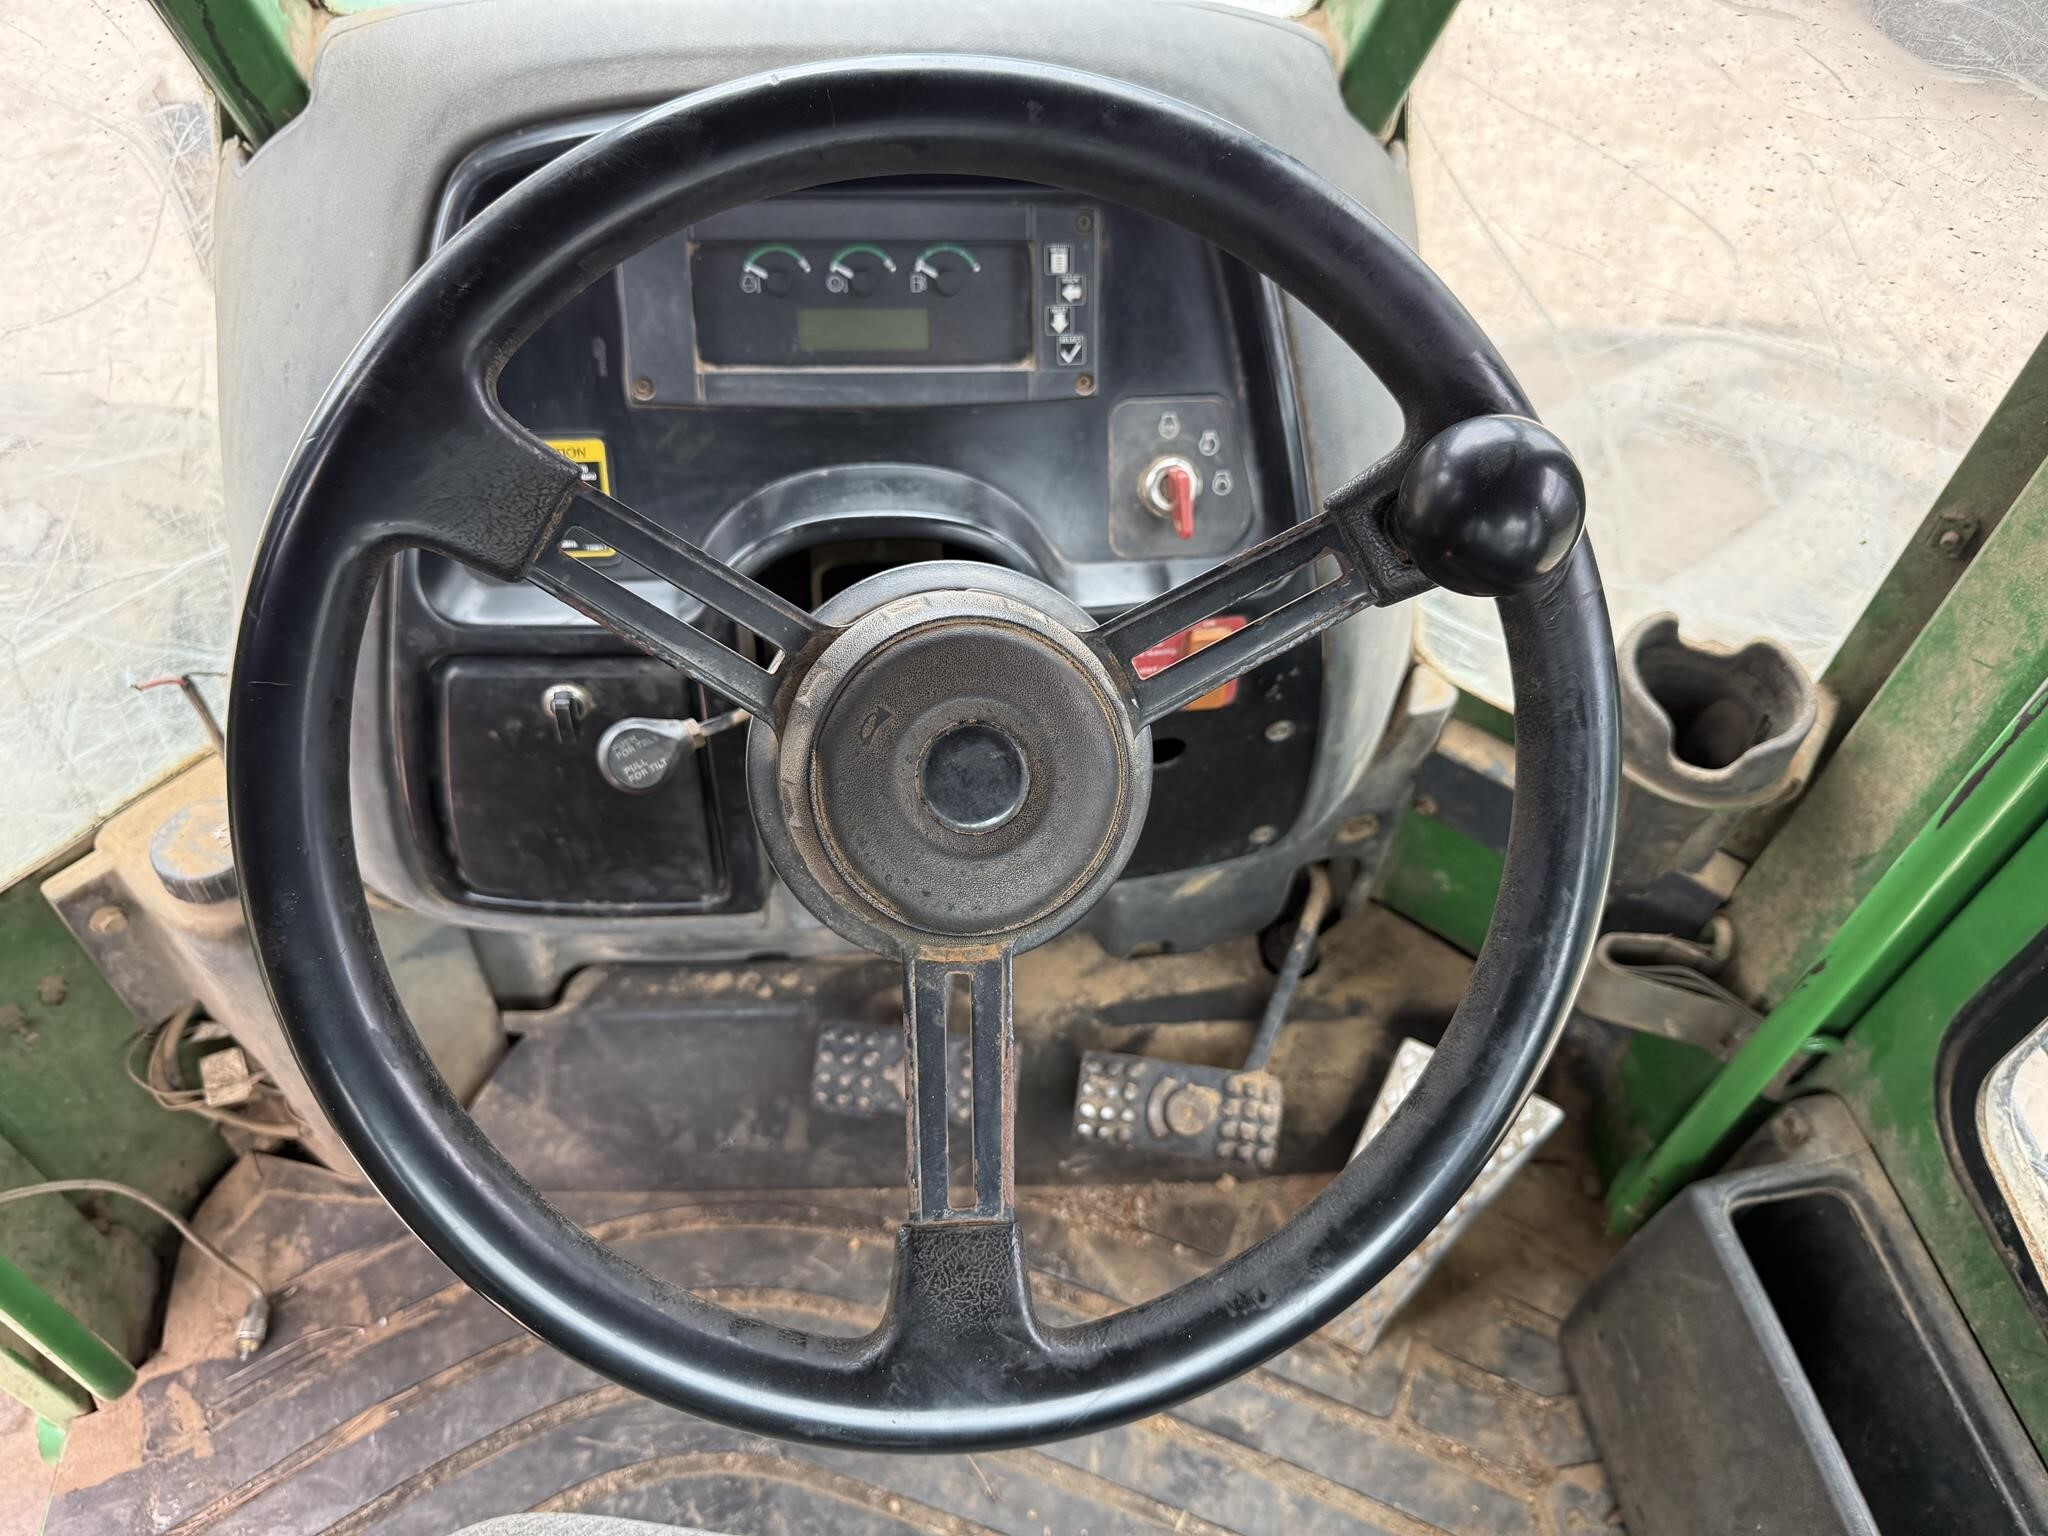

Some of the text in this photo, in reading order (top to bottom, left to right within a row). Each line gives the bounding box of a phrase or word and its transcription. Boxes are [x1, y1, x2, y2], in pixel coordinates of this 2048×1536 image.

[616, 746, 637, 759] FOR
[624, 760, 649, 775] PULL
[629, 758, 668, 782] FOR TILT
